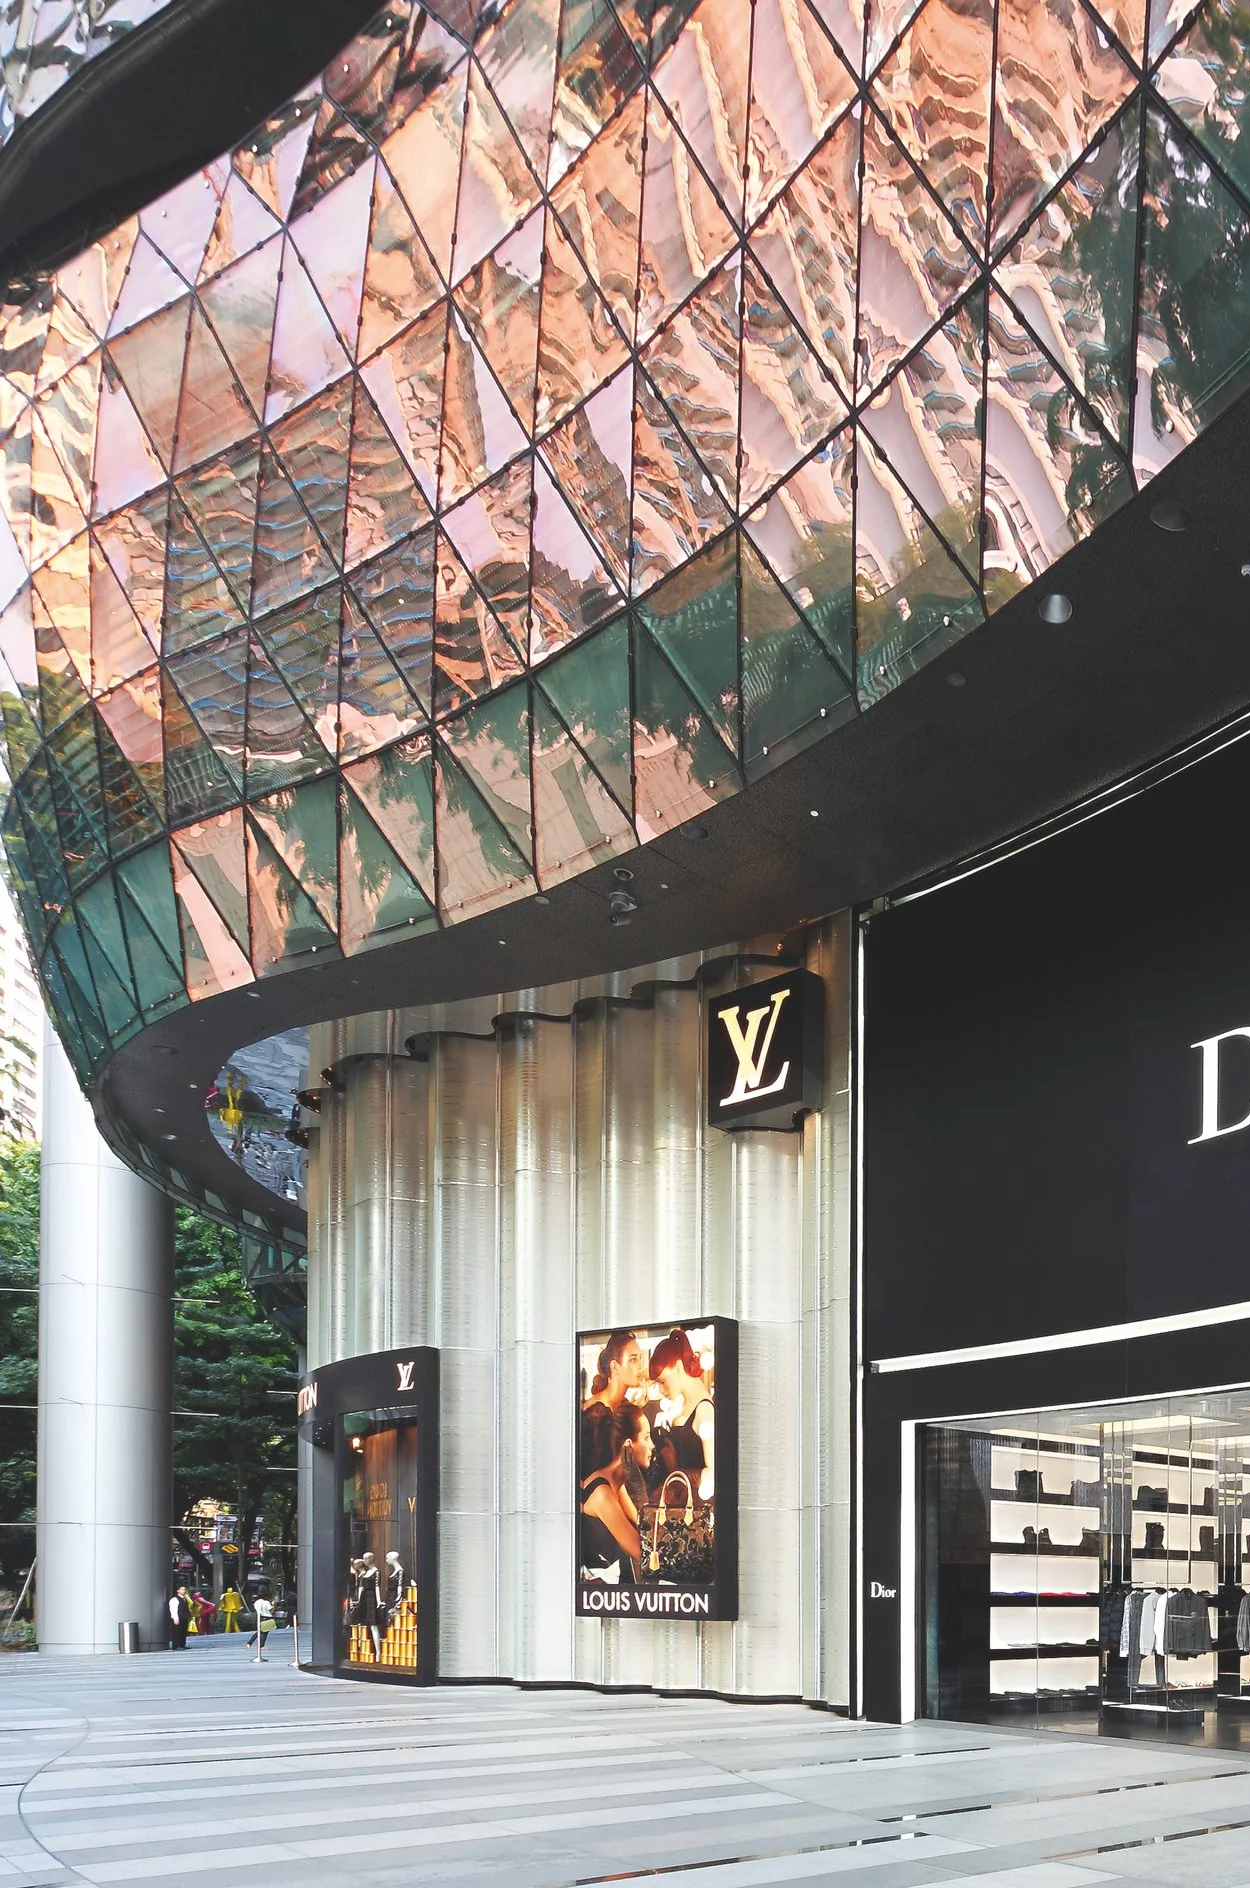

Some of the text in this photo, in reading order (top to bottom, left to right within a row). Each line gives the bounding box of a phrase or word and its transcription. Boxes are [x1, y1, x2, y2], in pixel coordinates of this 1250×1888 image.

[870, 1581, 897, 1598] Dior
[582, 1590, 709, 1614] LOUIS VUITTON
